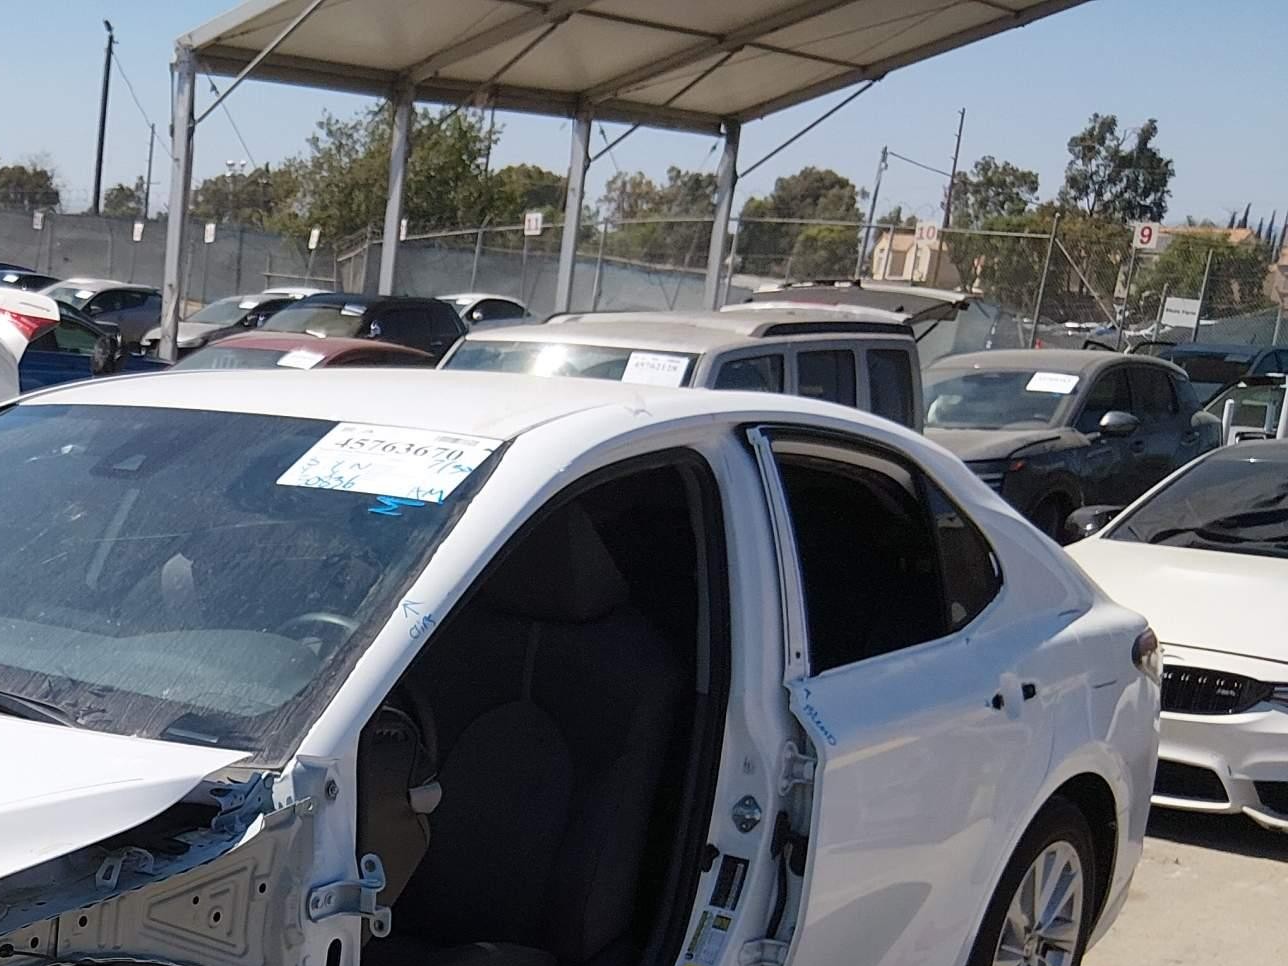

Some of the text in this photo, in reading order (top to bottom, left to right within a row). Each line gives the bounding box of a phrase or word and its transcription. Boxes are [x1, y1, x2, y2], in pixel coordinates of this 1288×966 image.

[916, 225, 936, 241] 10
[1140, 225, 1153, 245] 9
[335, 437, 465, 461] 45763670
